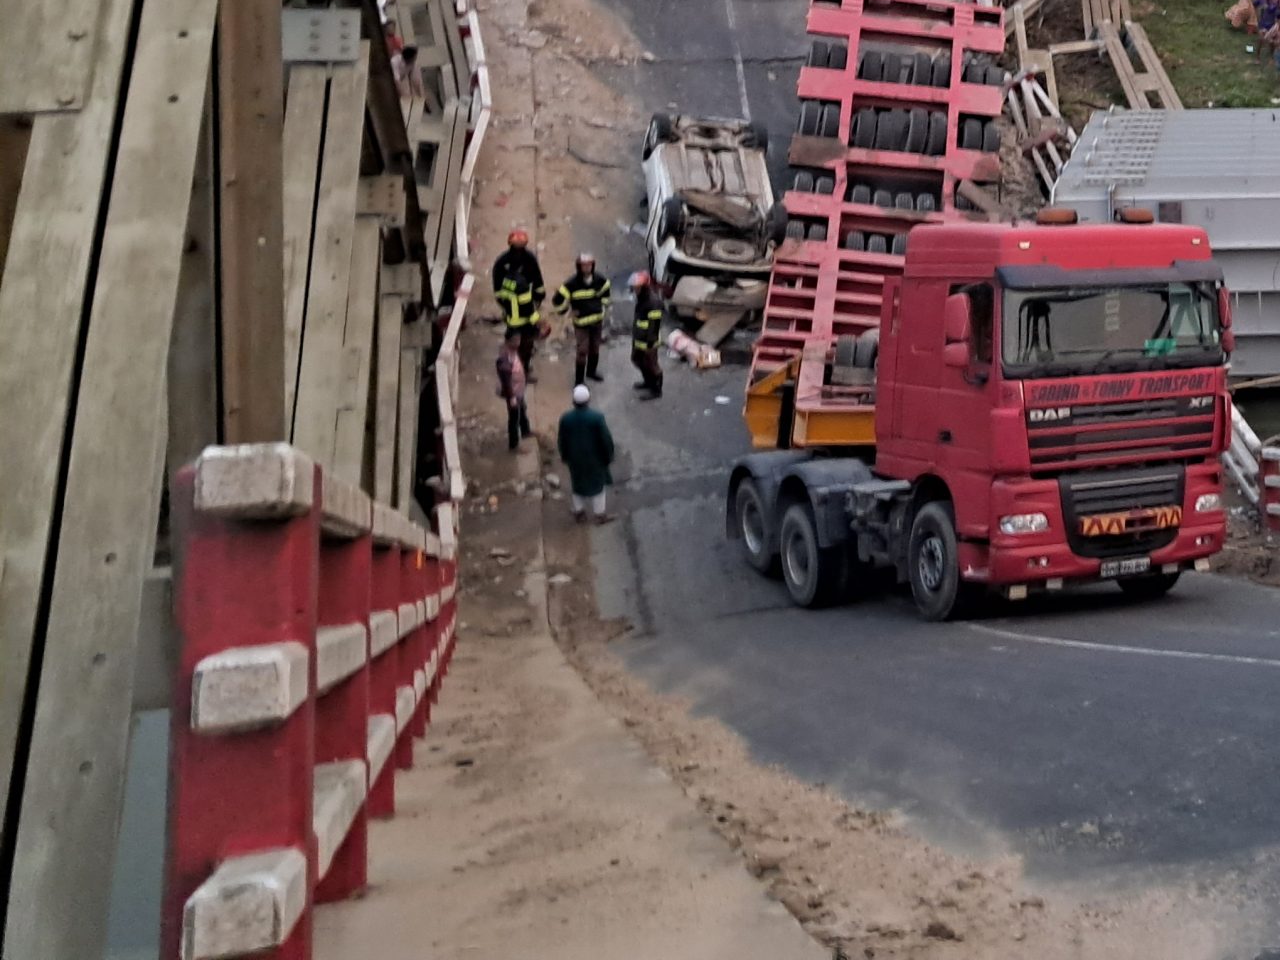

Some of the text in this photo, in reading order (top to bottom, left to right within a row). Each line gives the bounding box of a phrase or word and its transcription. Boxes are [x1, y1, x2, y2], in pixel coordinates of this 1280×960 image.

[1139, 373, 1212, 394] TRANSPORT
[1189, 396, 1213, 408] XF
[1030, 407, 1070, 422] DAF
